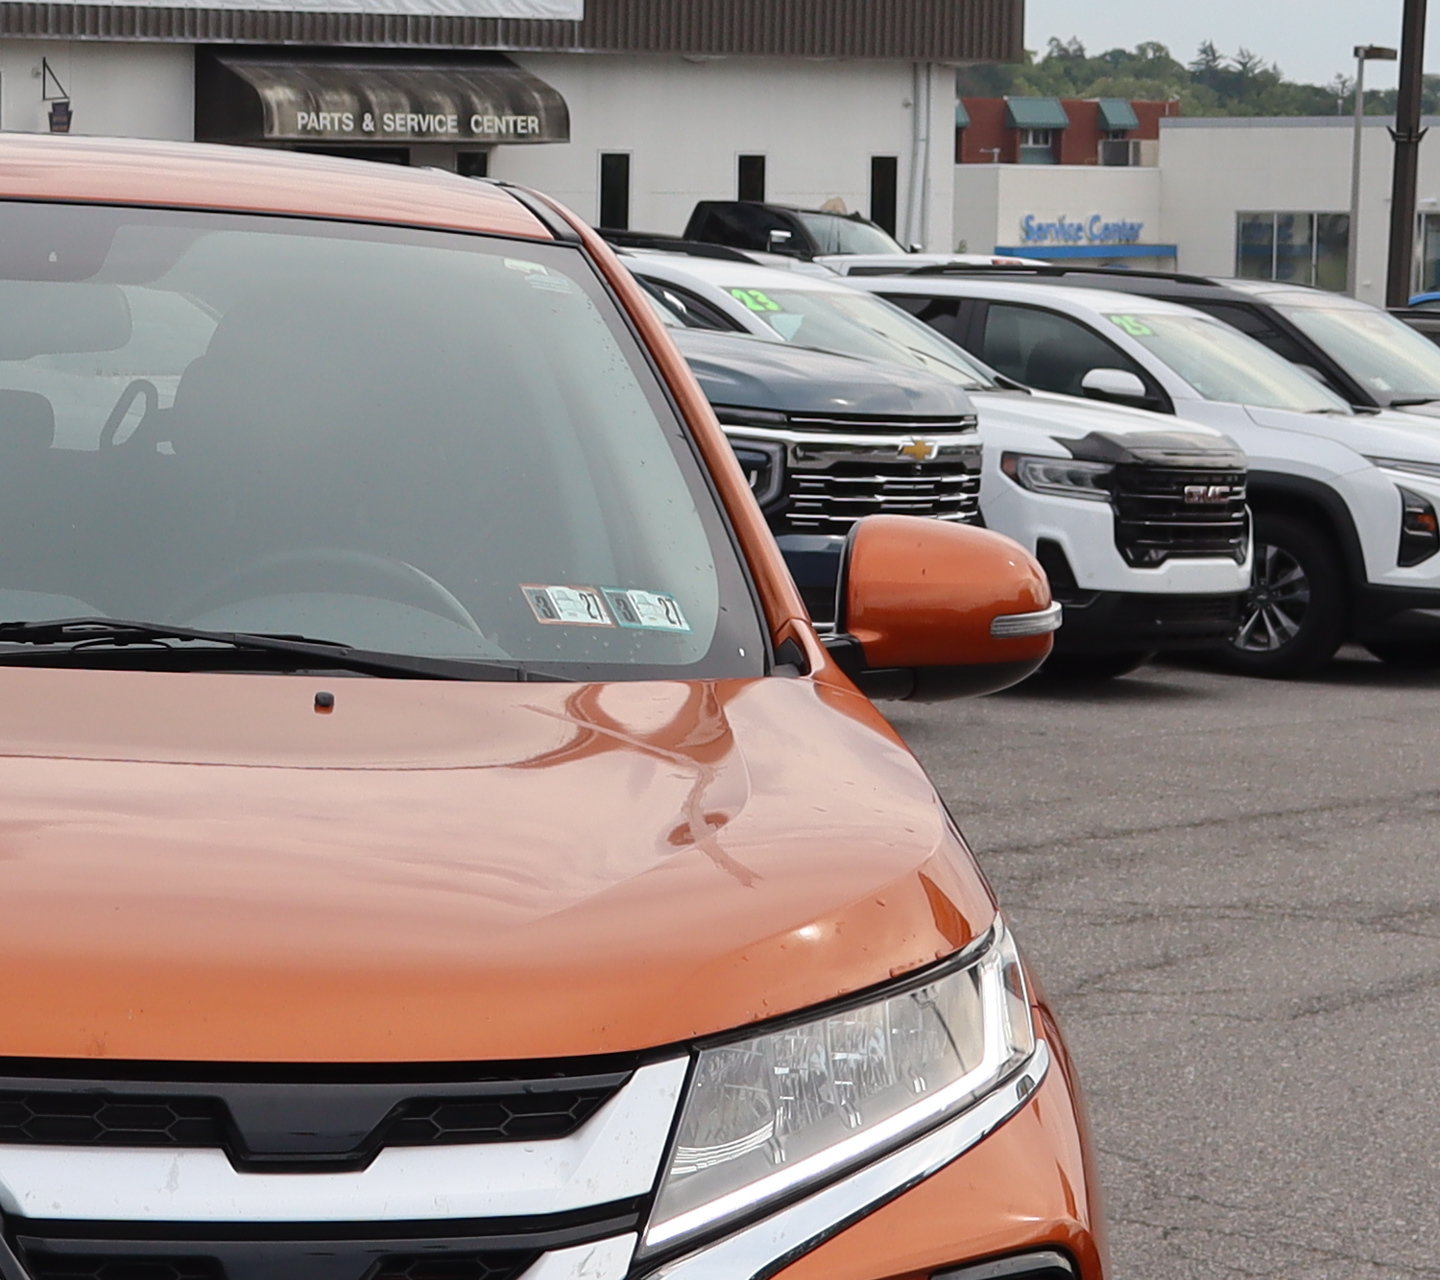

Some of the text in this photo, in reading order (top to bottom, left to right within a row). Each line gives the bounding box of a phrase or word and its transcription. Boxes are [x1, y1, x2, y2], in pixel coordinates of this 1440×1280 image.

[296, 111, 540, 134] PARTS & SERVICE CENTER
[1023, 213, 1144, 241] Service Center
[536, 592, 604, 622] 3 27
[618, 597, 683, 626] 3 27
